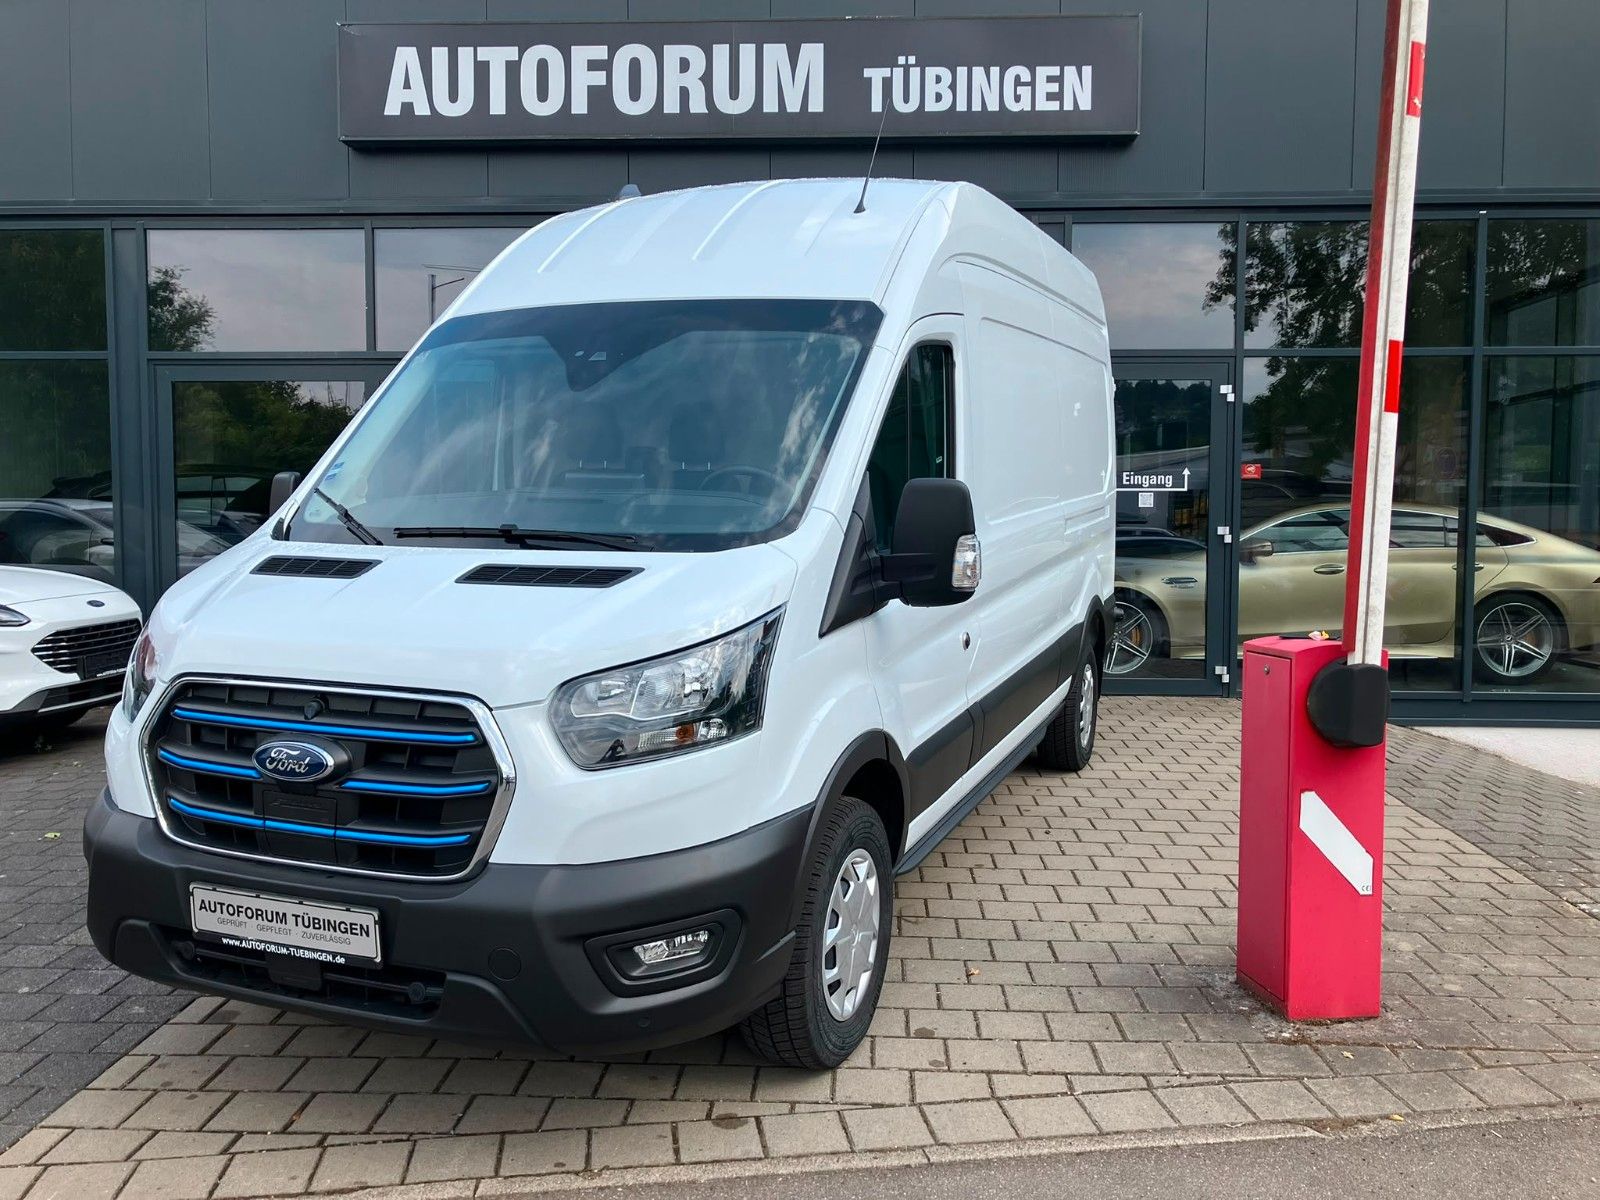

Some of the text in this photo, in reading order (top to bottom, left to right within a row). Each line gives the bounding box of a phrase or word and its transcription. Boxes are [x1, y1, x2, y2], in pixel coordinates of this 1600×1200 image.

[384, 43, 1092, 117] AUTOFORUM TÜBINGEN
[1122, 472, 1173, 487] Eingang
[266, 747, 311, 773] Ford
[199, 899, 370, 938] AUTOFORUM TÜBINGEN
[256, 923, 292, 936] GEPFLEGT
[221, 937, 346, 964] www.AUTOFORUM-TUEBINGEN.de
